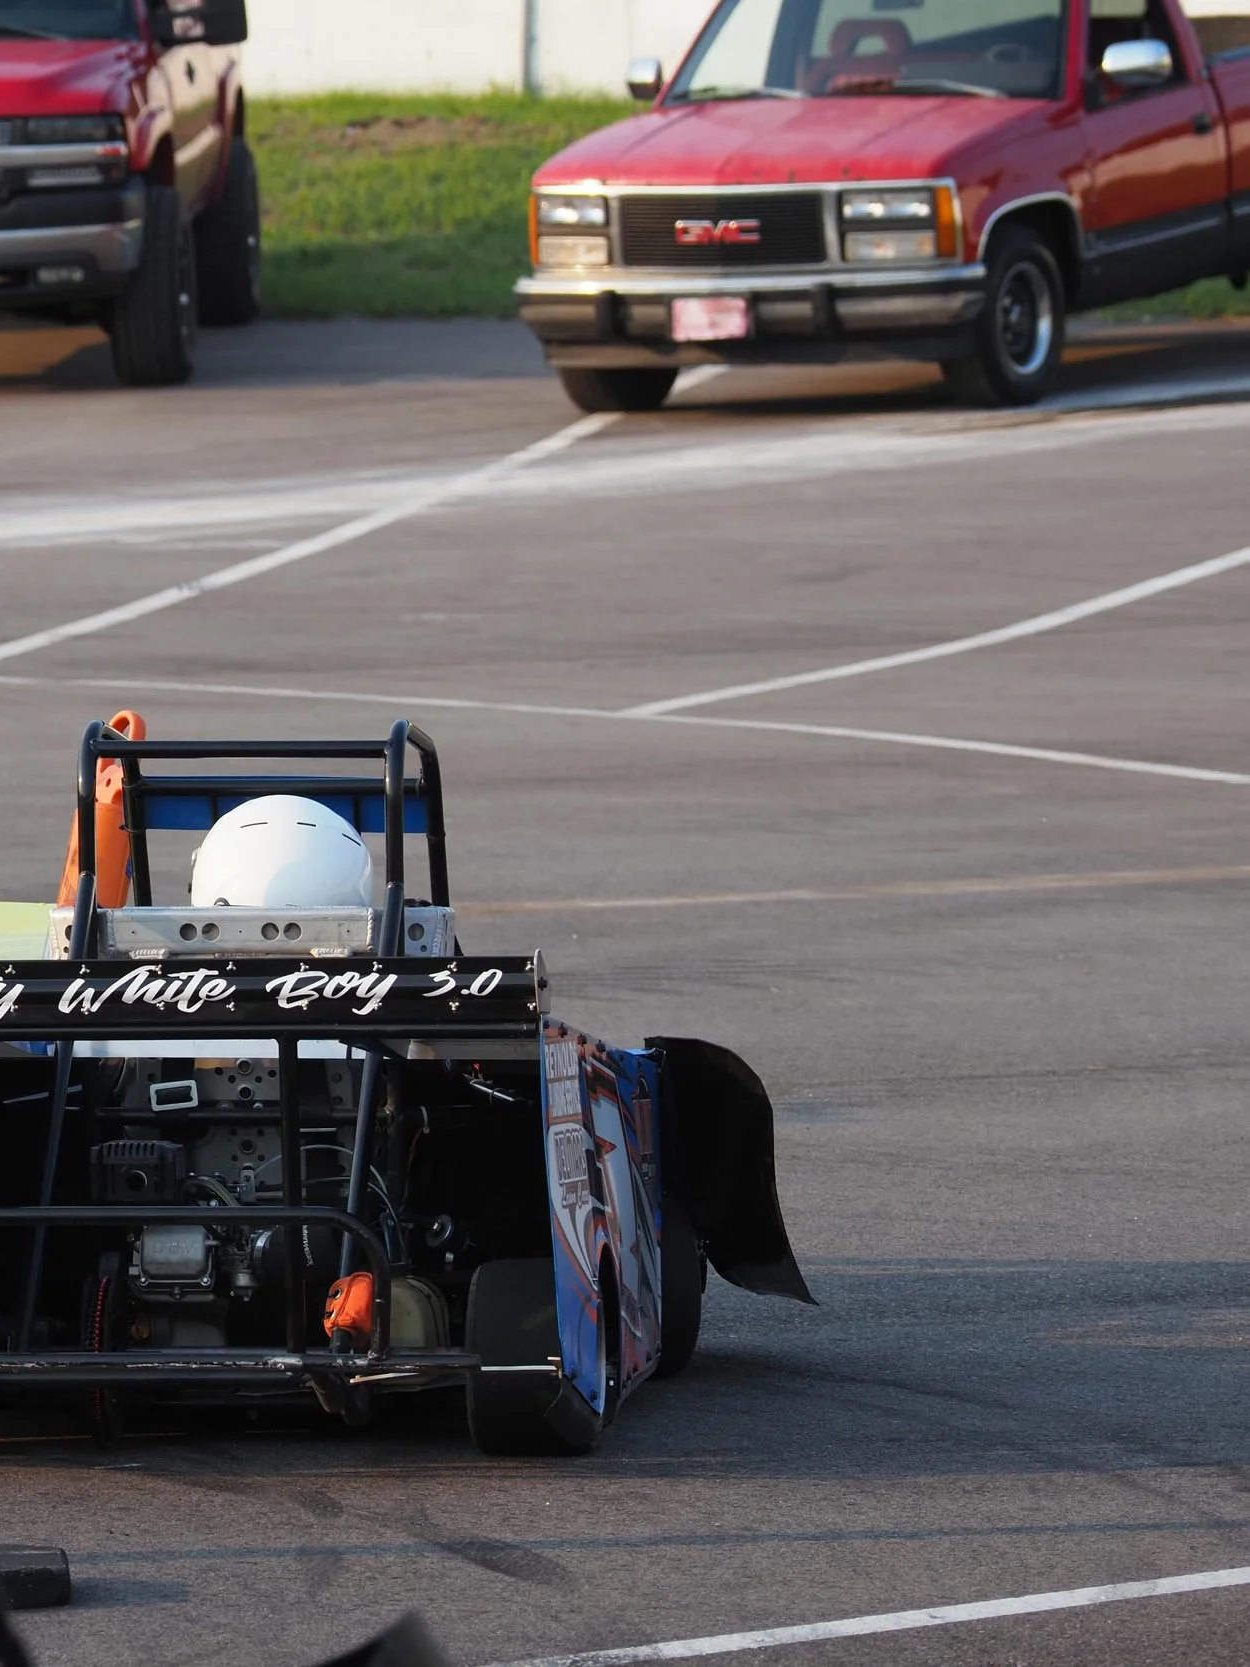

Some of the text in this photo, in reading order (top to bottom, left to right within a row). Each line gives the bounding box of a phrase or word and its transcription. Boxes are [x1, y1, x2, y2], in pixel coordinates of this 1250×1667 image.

[674, 218, 762, 246] GMC
[58, 964, 237, 1015] White
[264, 963, 400, 1017] Boy
[422, 968, 503, 1000] 3.0
